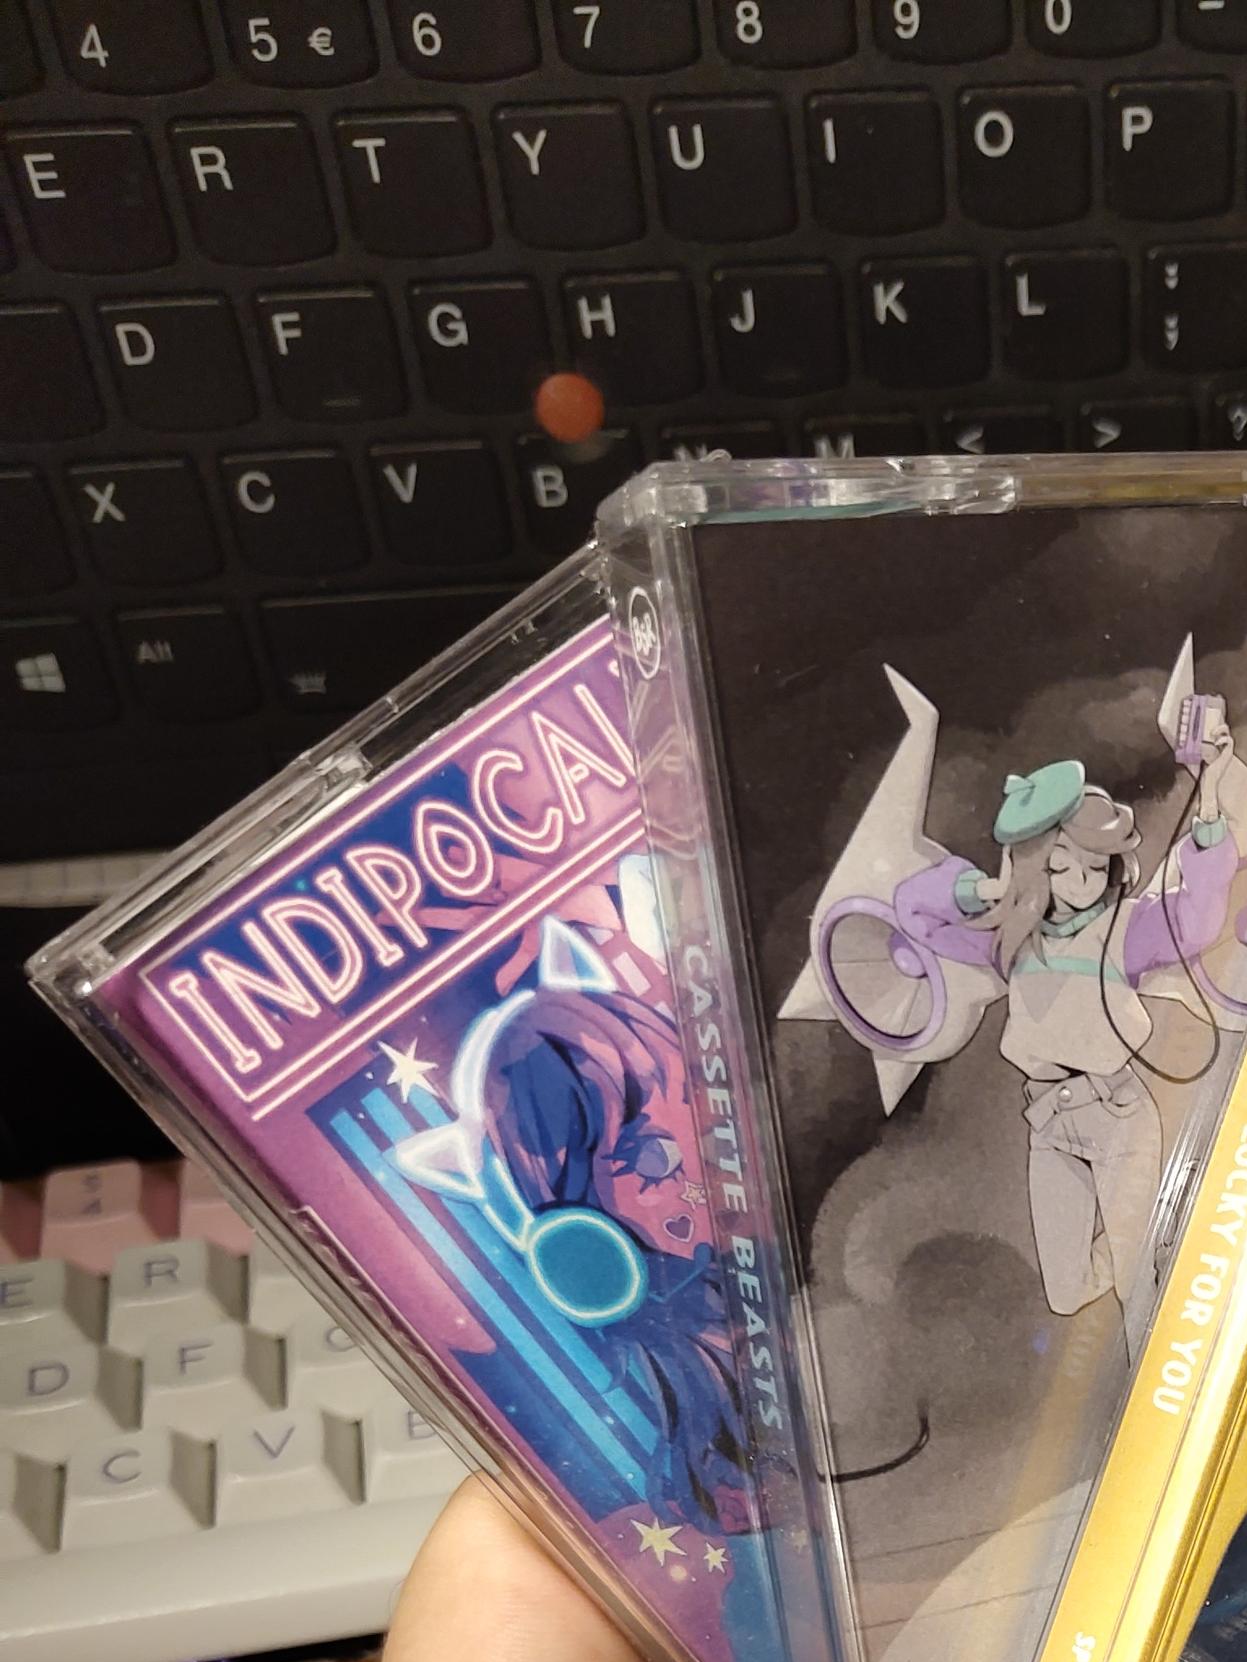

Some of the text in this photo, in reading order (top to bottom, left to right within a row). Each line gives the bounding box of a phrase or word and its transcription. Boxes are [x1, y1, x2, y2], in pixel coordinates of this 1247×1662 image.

[80, 23, 110, 68] 4
[248, 17, 278, 62] 5
[412, 12, 442, 56] 6
[573, 5, 600, 49] 7
[735, 0, 763, 44] 8
[22, 152, 66, 199] E
[189, 145, 234, 192] R
[351, 137, 386, 184] T
[512, 129, 547, 175] Y
[668, 123, 705, 170] U
[974, 110, 1014, 158] O
[1121, 106, 1153, 152] P
[115, 273, 1046, 366] D F G H J K L
[83, 482, 125, 524] X
[237, 471, 276, 514] C
[383, 463, 418, 504] V
[532, 466, 569, 508] B
[683, 945, 784, 1431] CASSETTE BEASTS
[143, 1254, 181, 1289] R
[1179, 1254, 1229, 1326] FOR
[27, 1361, 70, 1397] D
[178, 1342, 214, 1375] F
[1152, 1336, 1198, 1416] YOU
[103, 1450, 142, 1484] C
[254, 1425, 295, 1459] V
